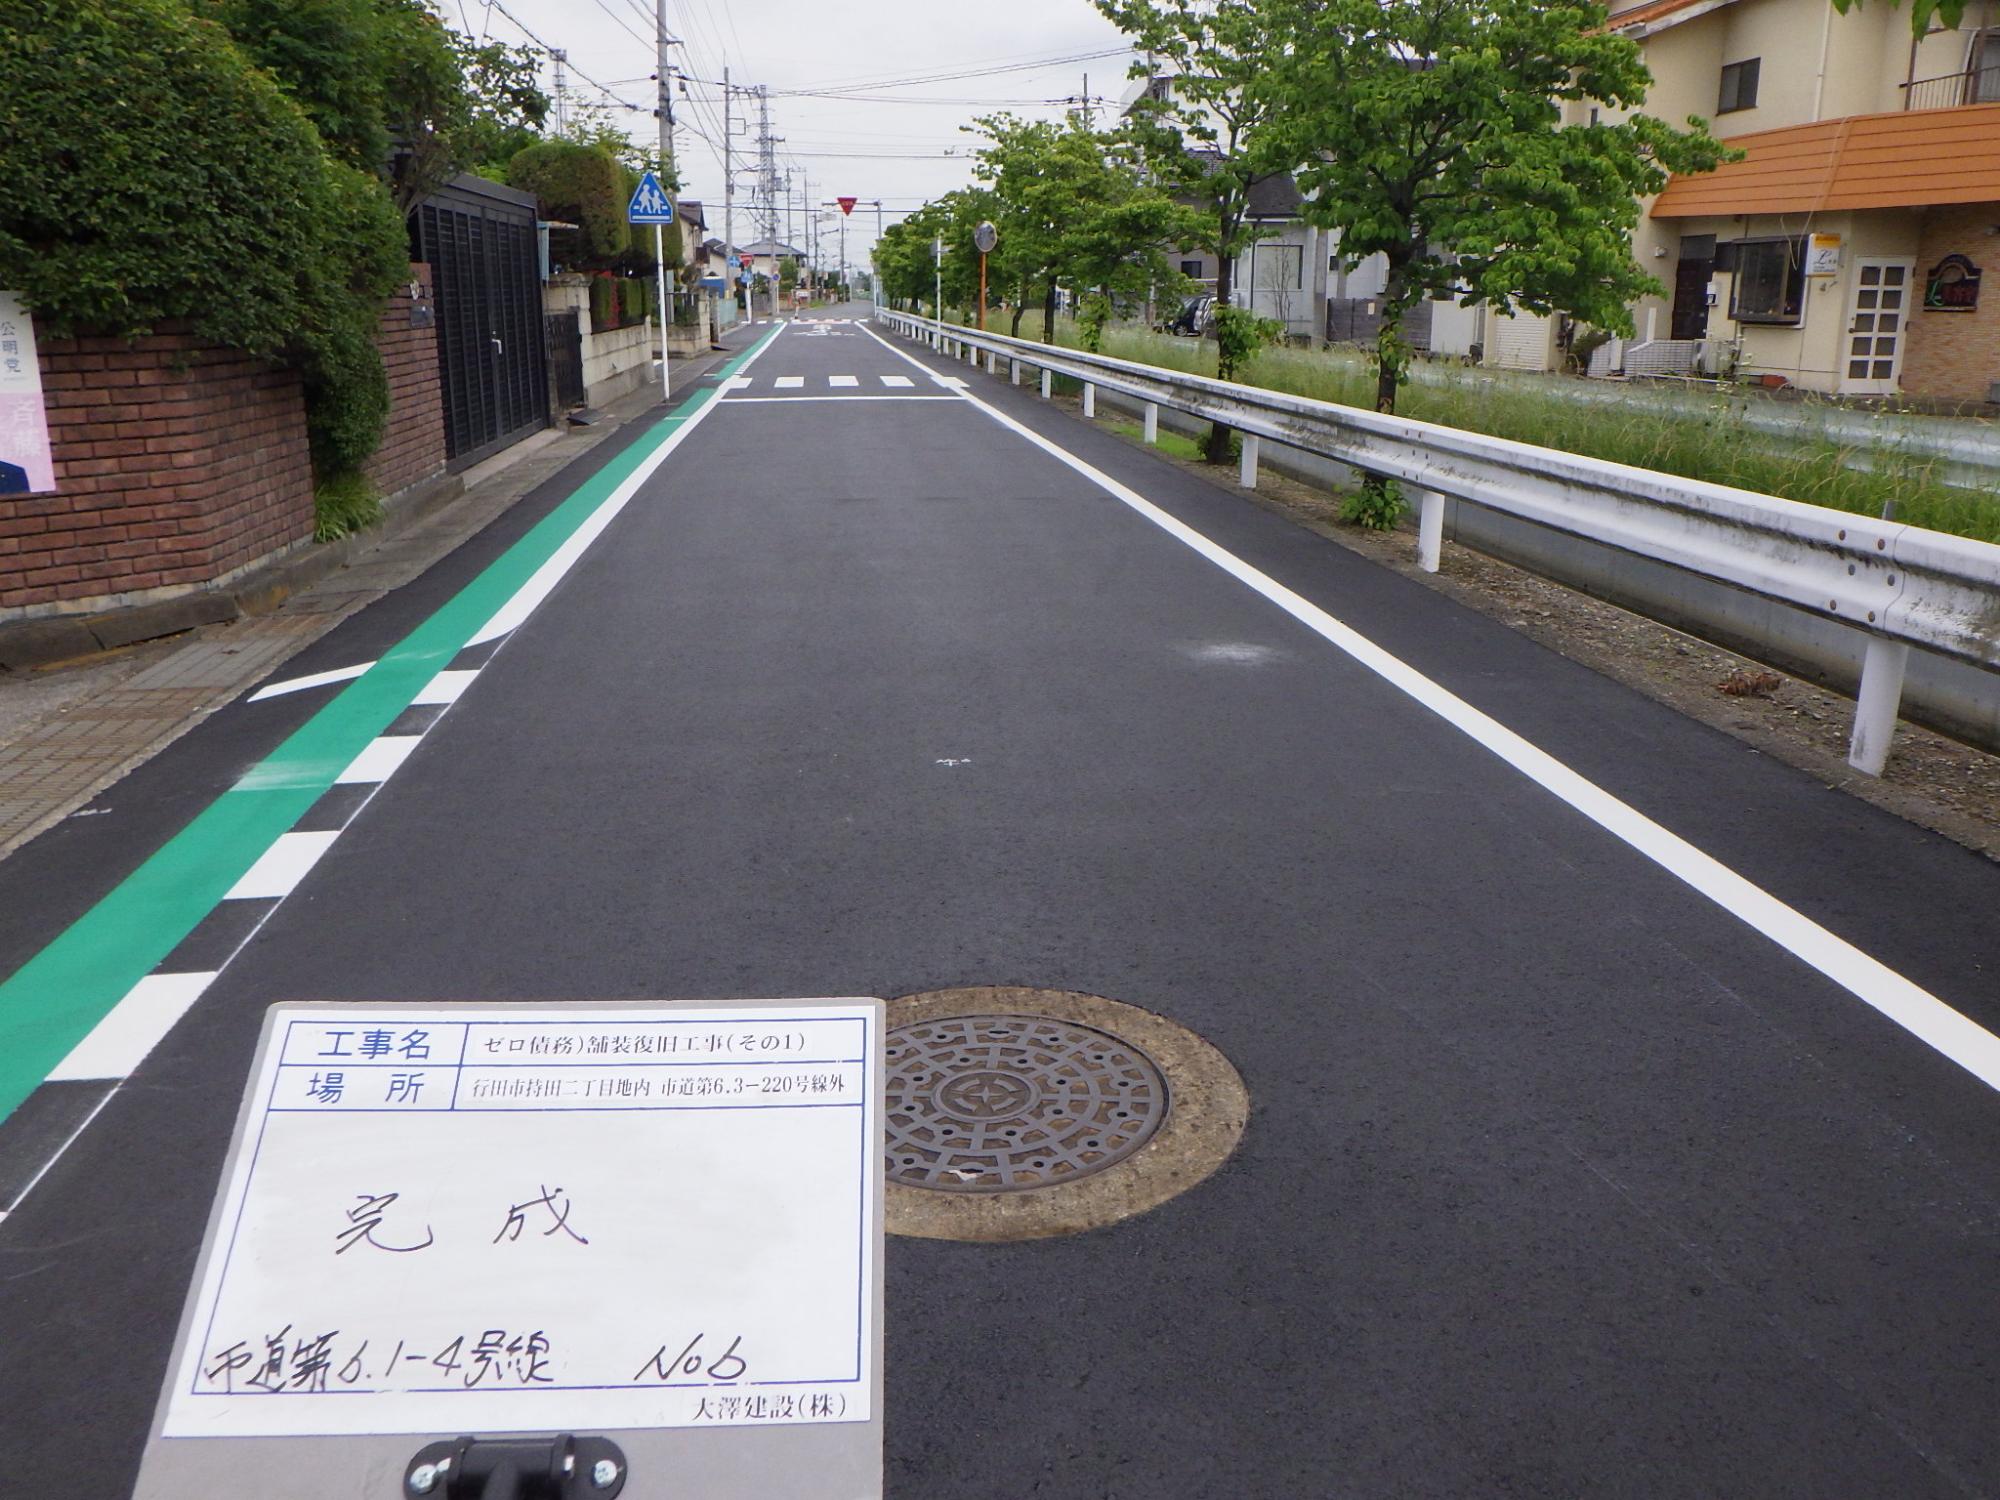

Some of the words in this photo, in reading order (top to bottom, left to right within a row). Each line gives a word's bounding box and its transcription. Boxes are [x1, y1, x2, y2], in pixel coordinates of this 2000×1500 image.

[1, 320, 21, 373] 公明党
[317, 1028, 431, 1060] 工事名
